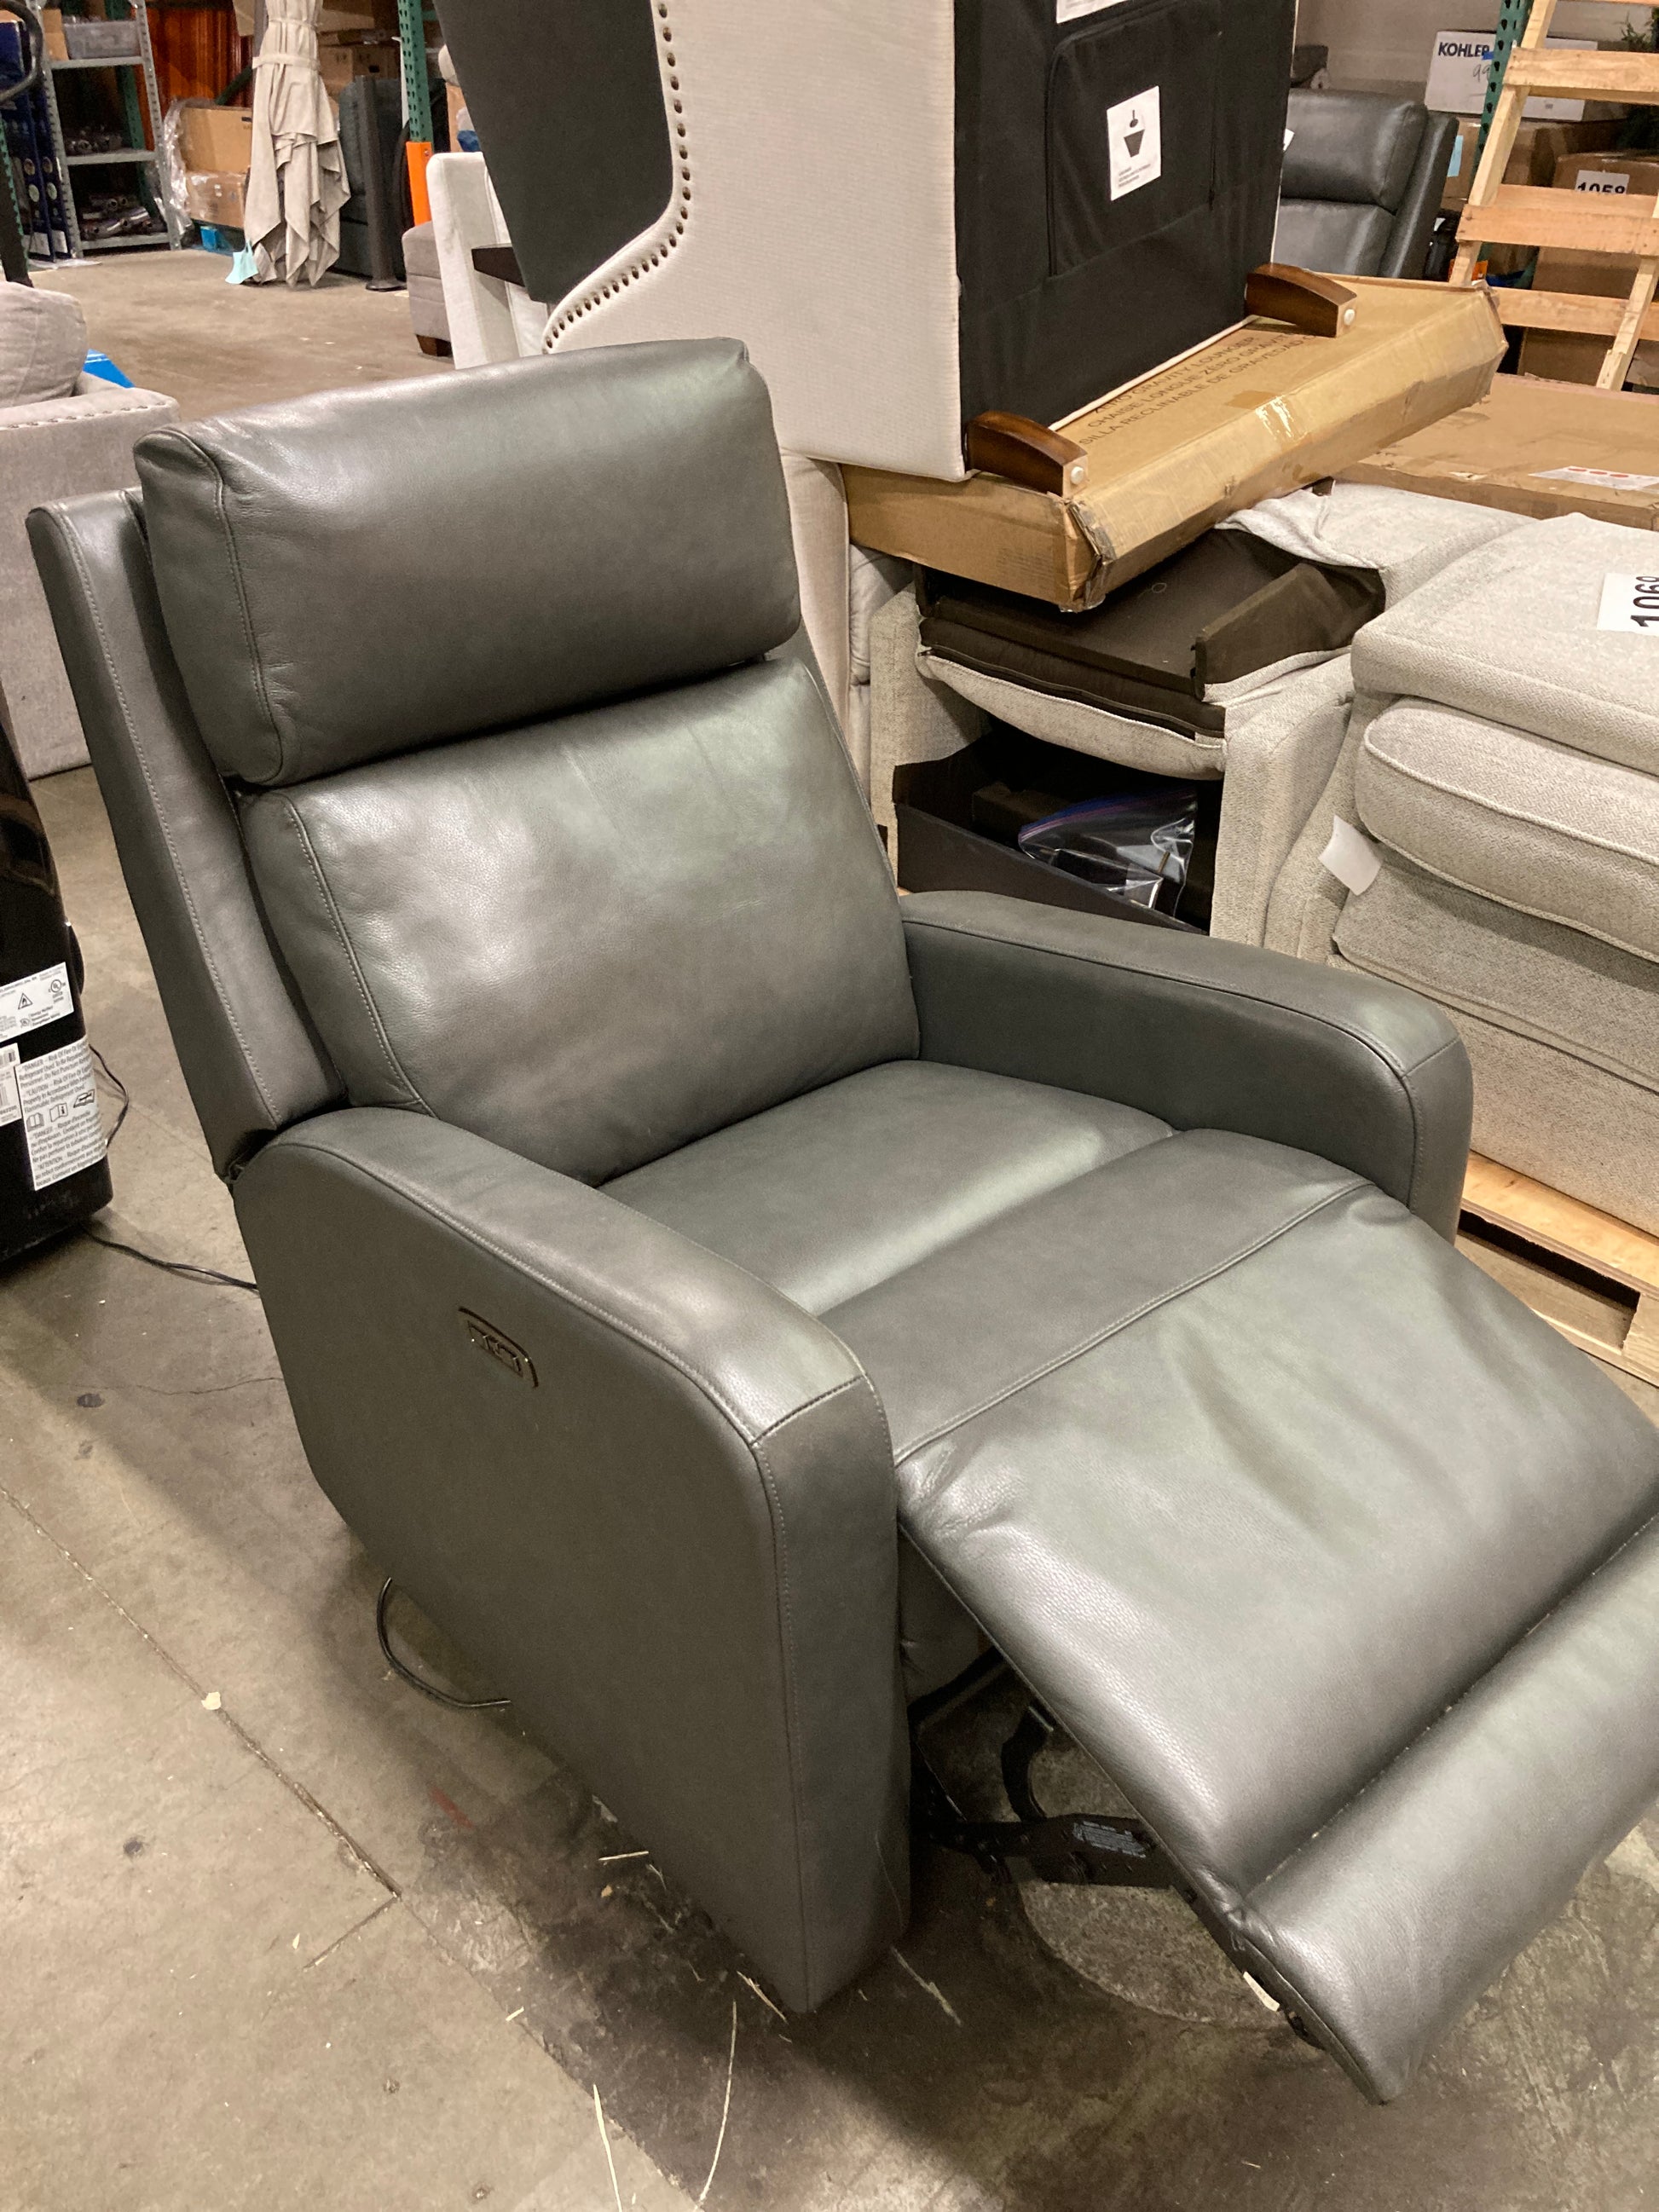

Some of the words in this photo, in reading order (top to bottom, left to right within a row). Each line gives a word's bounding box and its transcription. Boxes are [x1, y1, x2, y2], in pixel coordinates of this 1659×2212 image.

[1088, 401, 1143, 427] CHAISE
[1141, 374, 1203, 402] LONGUE
[1132, 367, 1191, 396] GRAVITY
[1078, 424, 1124, 444] SILLA
[1120, 384, 1209, 426] RECLINABLE
